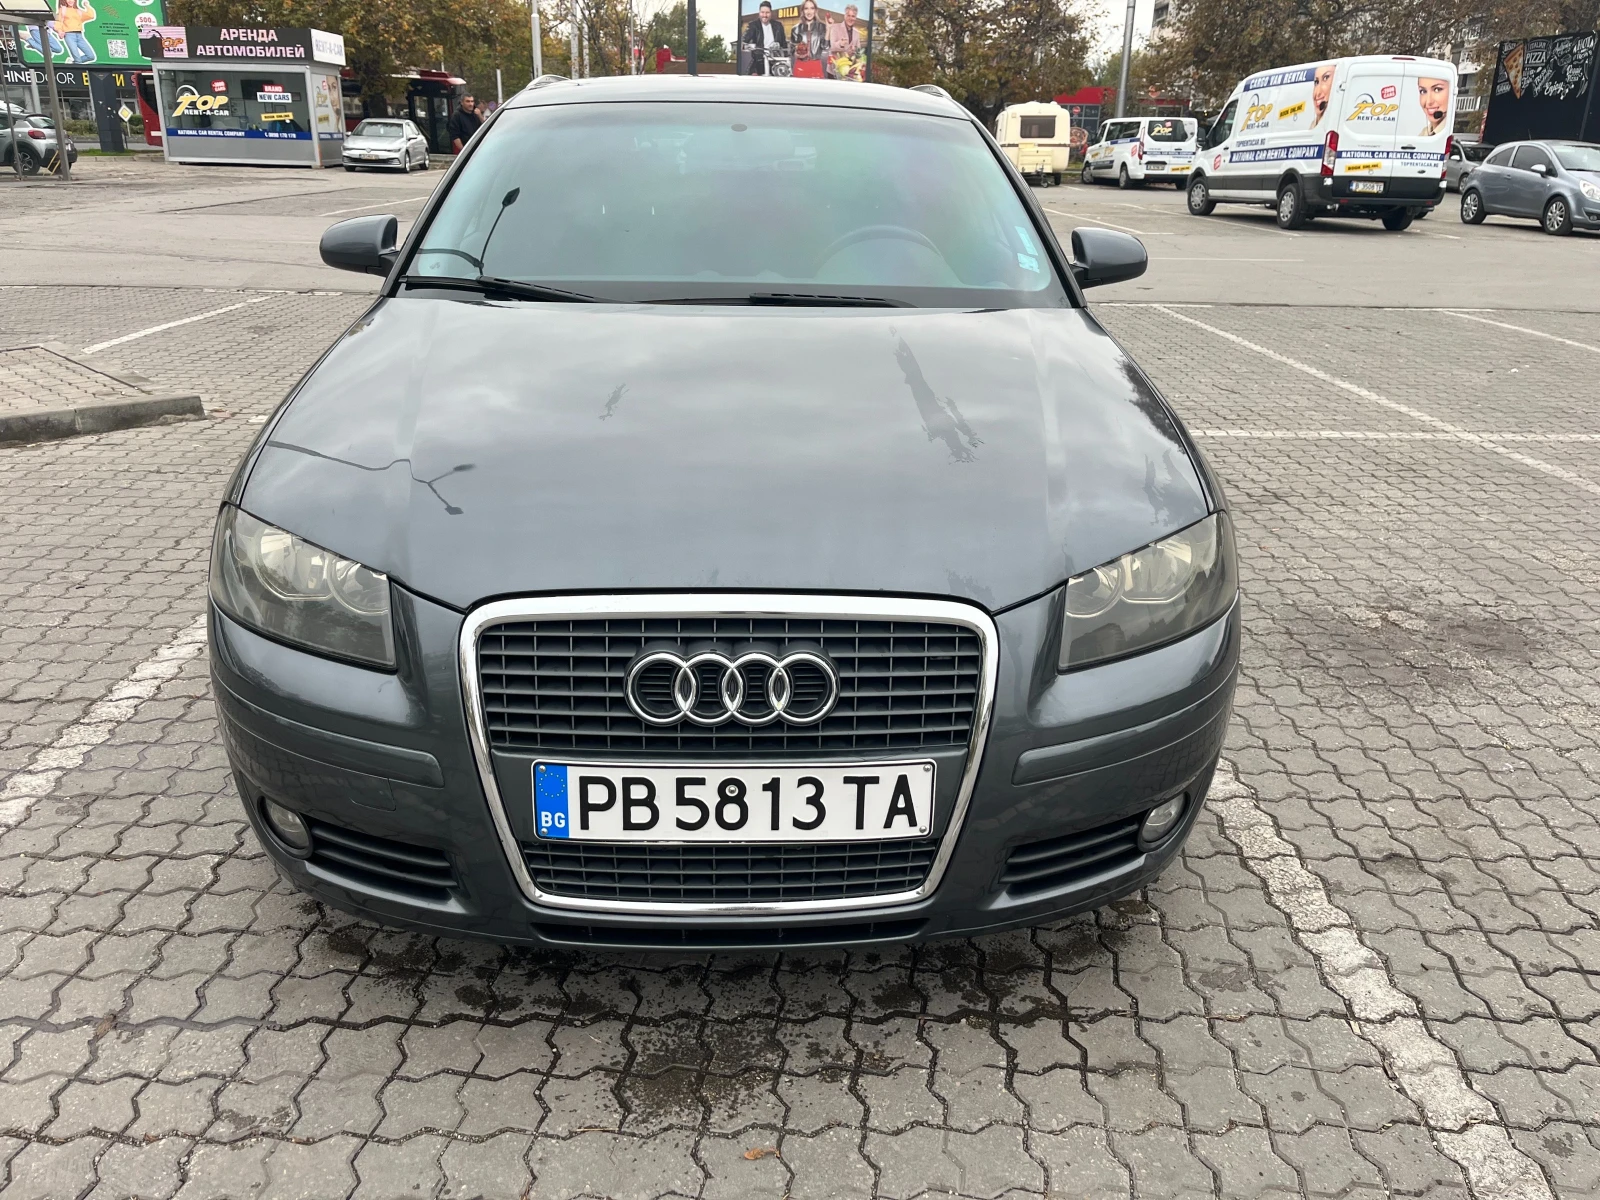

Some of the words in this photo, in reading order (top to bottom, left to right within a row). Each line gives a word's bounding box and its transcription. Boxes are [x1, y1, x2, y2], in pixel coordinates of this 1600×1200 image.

[778, 7, 798, 18] BILLA
[220, 28, 278, 43] АРЕНДА
[196, 44, 305, 58] АВТОМОБИЛЕЙ
[1525, 51, 1546, 64] PIZZA
[1249, 76, 1269, 89] CARGO
[1270, 74, 1283, 85] VAN
[1283, 70, 1307, 83] RENTAL
[171, 94, 229, 117] TOP
[1345, 103, 1399, 121] TOP
[1240, 103, 1274, 132] TOP
[1246, 121, 1269, 130] RENT-A-CAR
[1150, 126, 1172, 136] TOP
[1232, 151, 1255, 162] NATIONAL
[1255, 149, 1267, 161] CAR
[1267, 147, 1287, 160] RENTAL
[1288, 145, 1319, 158] COMPANY
[579, 775, 660, 831] PB
[675, 776, 827, 831] 5813
[843, 774, 918, 830] TA
[541, 811, 566, 828] BG
